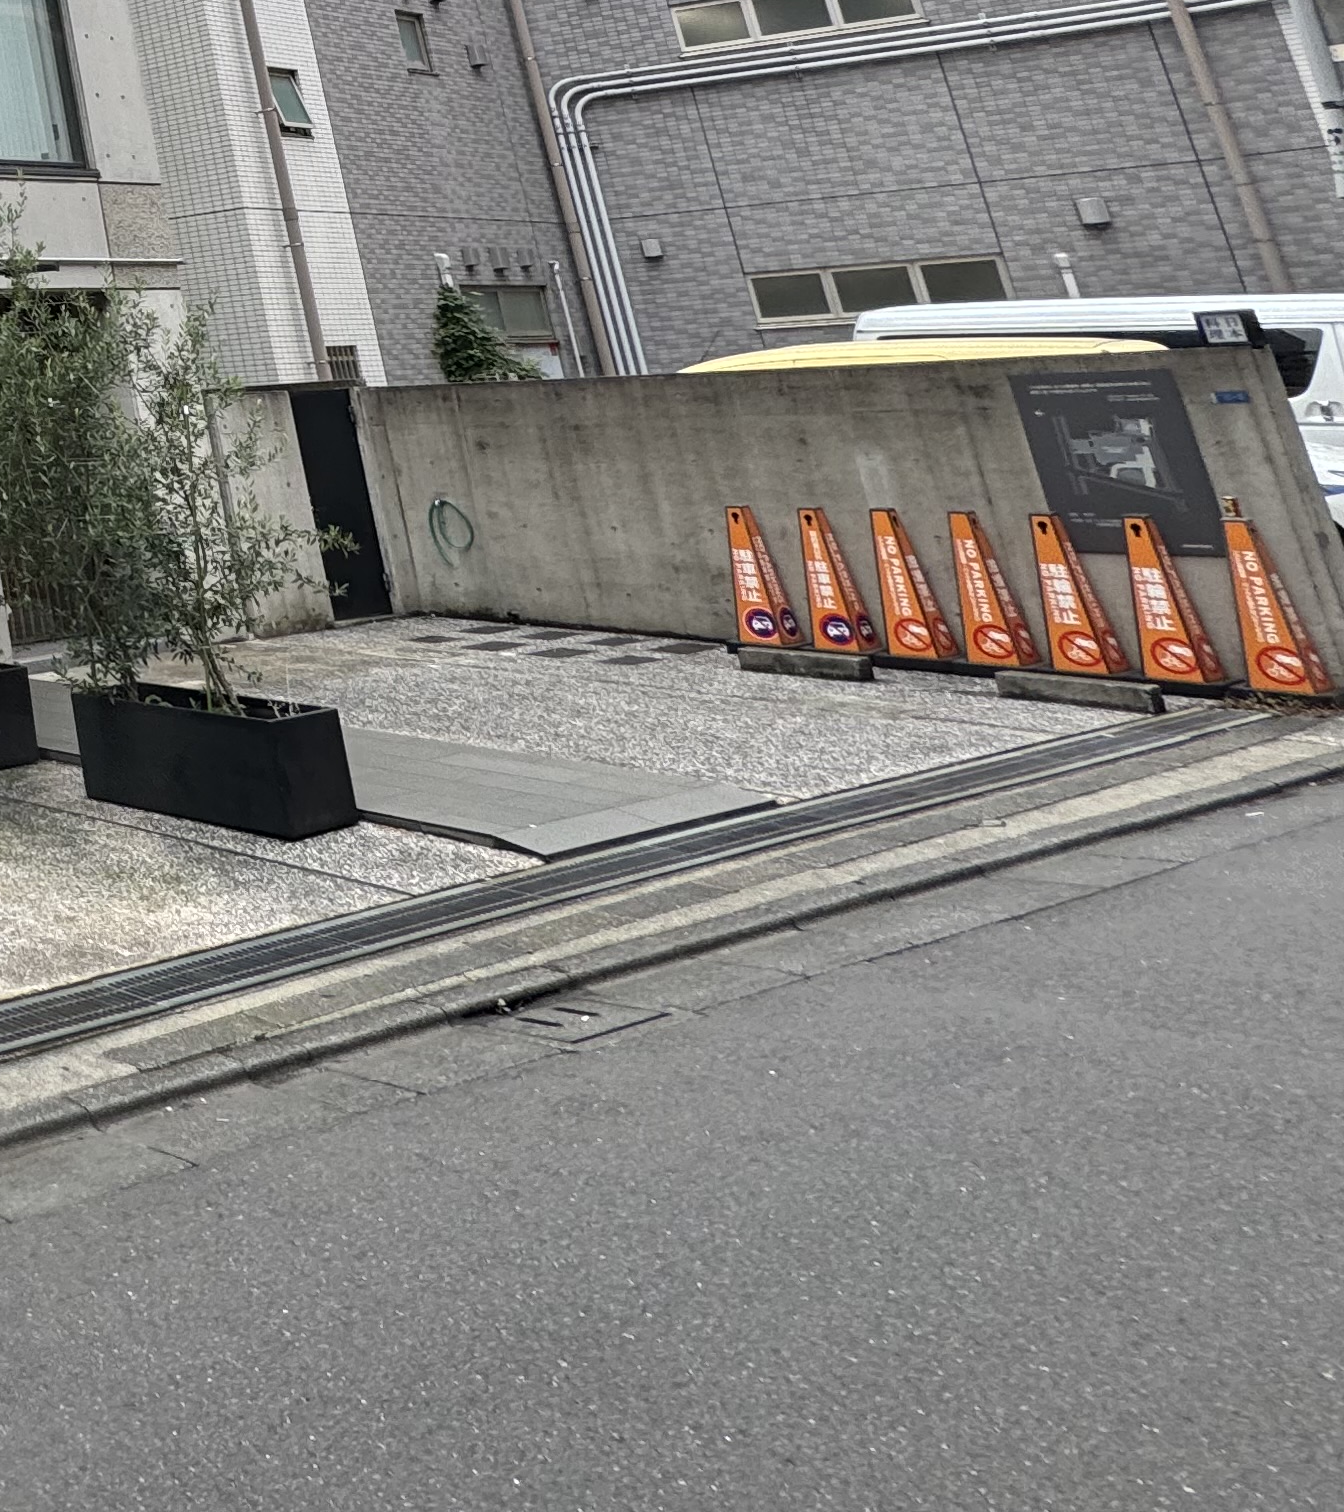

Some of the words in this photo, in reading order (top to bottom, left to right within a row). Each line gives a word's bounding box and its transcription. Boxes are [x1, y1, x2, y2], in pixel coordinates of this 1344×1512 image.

[883, 536, 897, 555] NO
[963, 539, 977, 559] NO
[1241, 550, 1259, 572] NO
[888, 557, 912, 617] PARKING
[969, 563, 993, 623] PARKING
[1248, 576, 1280, 644] PARKING
